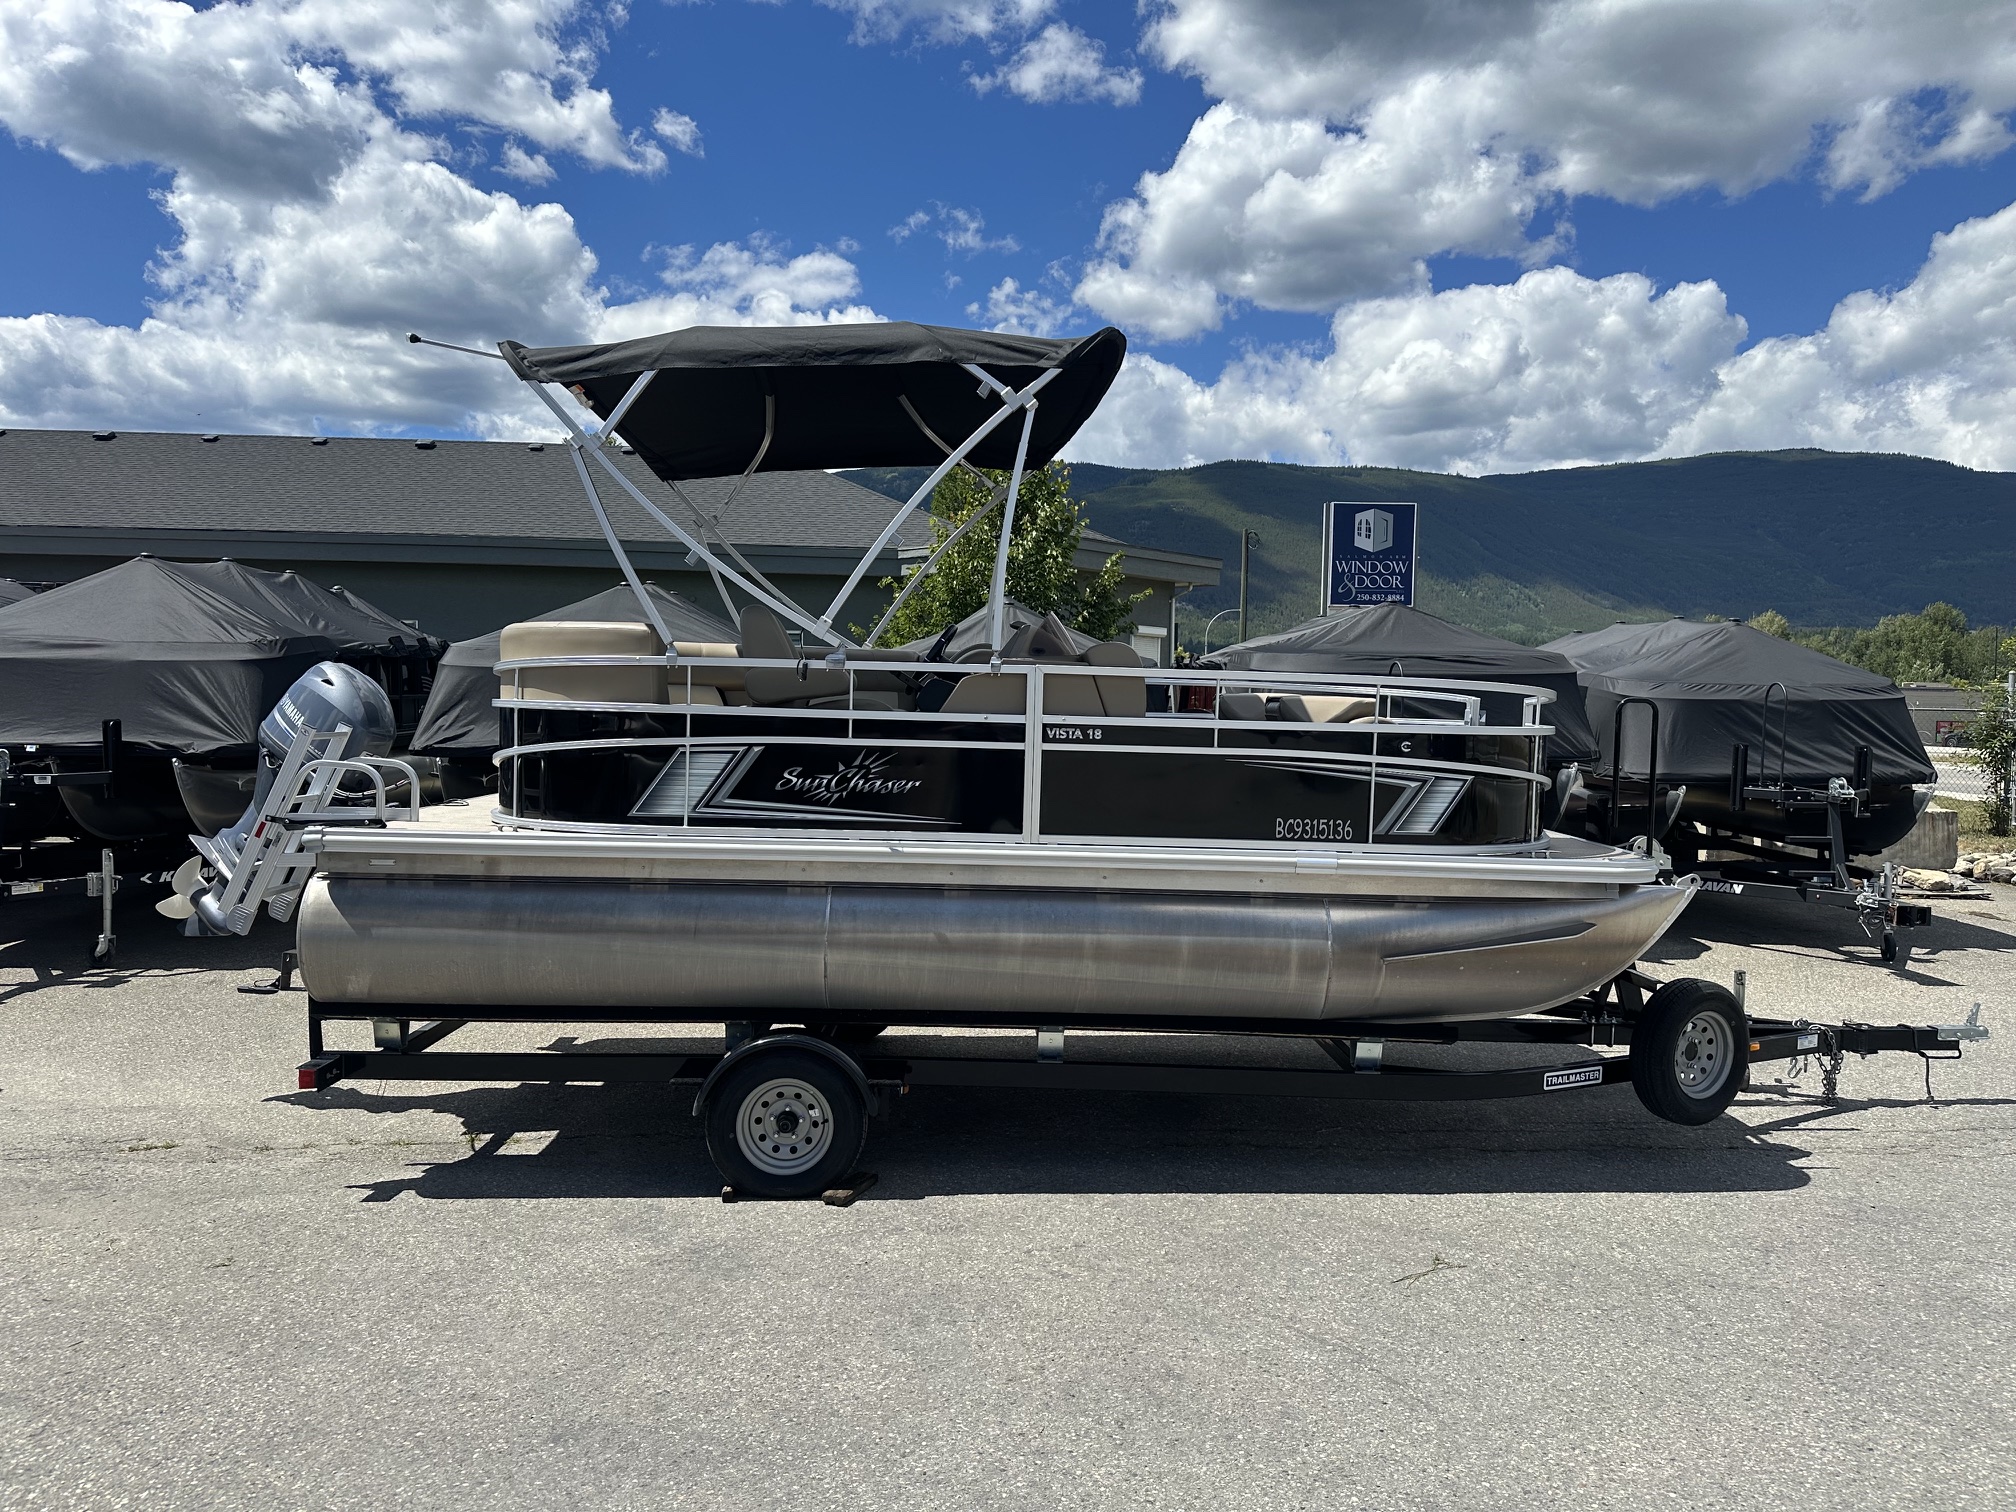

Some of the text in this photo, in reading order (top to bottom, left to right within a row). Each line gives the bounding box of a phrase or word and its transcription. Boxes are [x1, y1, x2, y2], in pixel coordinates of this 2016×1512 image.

[1335, 560, 1409, 574] WINDOW
[1337, 572, 1405, 602] & DOOR
[282, 699, 305, 728] YAMAHA
[1046, 727, 1102, 739] VISTA 18
[775, 766, 922, 794] SunChaser
[1275, 817, 1353, 840] BC9315136
[1700, 880, 1744, 895] AVAN
[1547, 1070, 1600, 1086] TRAILMASTER
